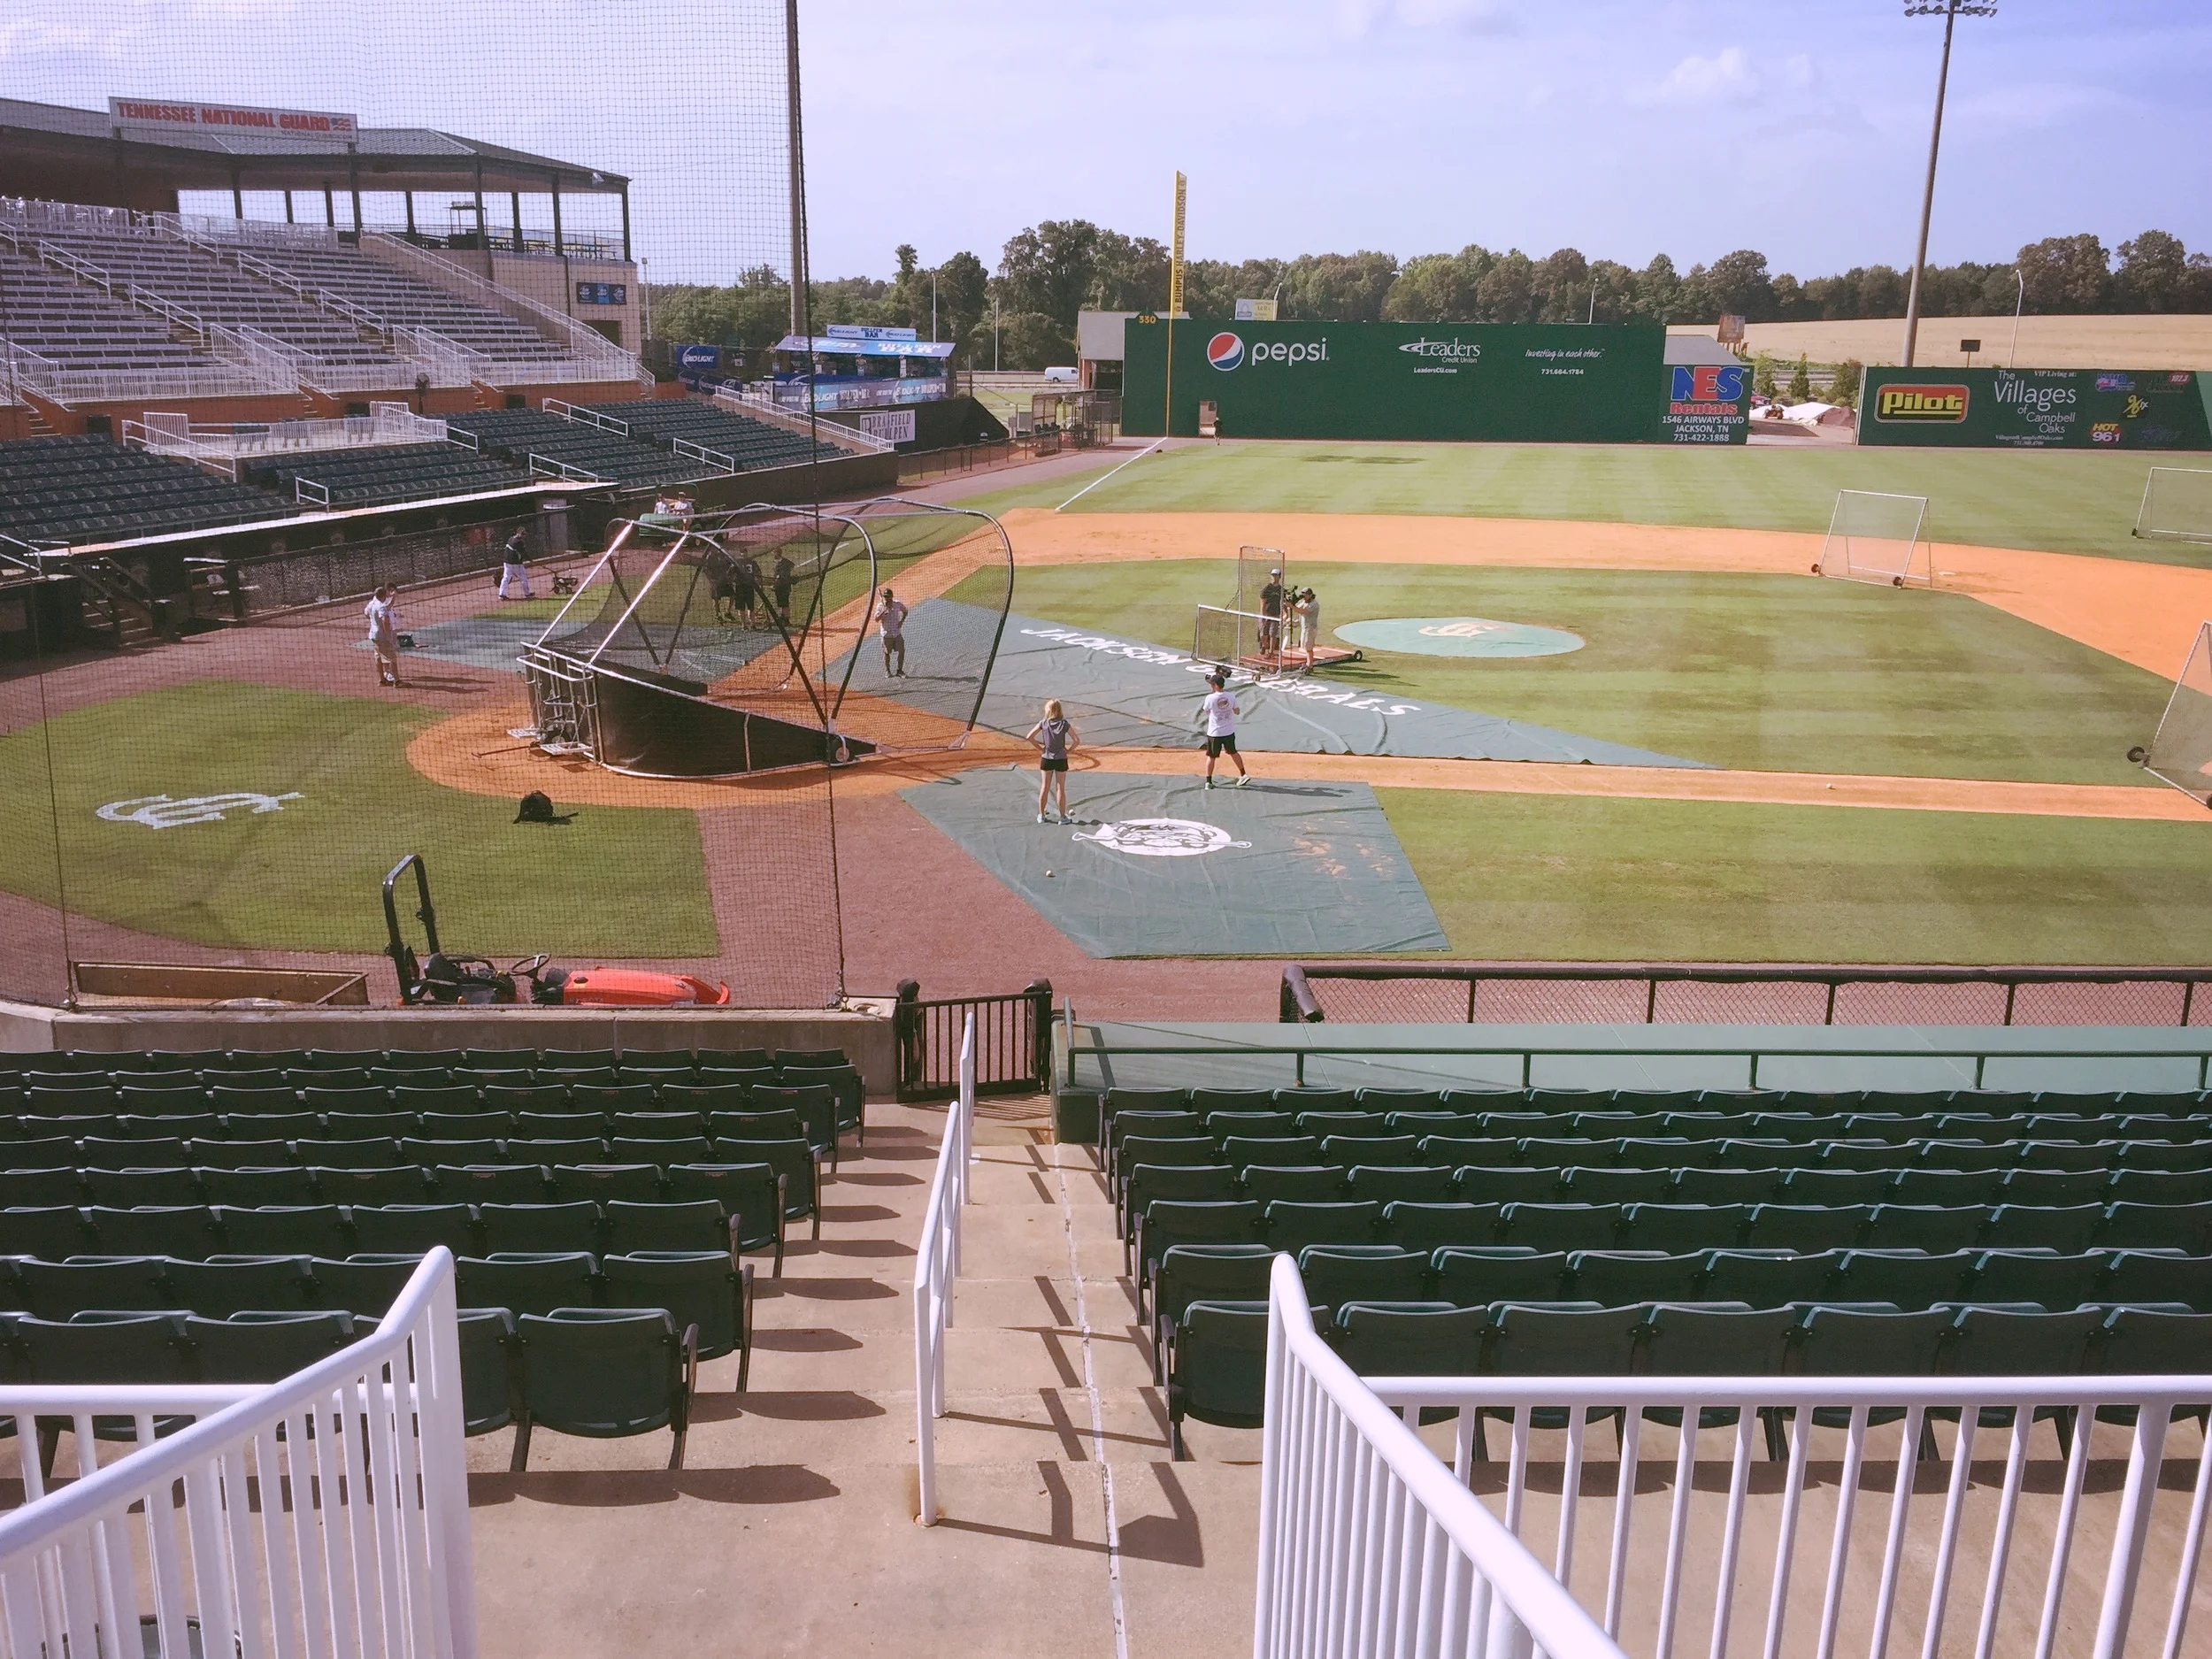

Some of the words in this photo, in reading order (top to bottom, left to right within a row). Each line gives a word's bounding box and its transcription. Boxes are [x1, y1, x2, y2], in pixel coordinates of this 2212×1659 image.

[117, 102, 196, 123] TENNESSEE
[201, 108, 276, 128] NATIONAL
[279, 113, 331, 132] GUARD
[1176, 188, 1187, 266] HARLEY-DAVIDSON
[1174, 270, 1184, 303] BUMPUS
[1251, 337, 1326, 366] pepsi
[1419, 336, 1481, 357] Leaders
[1525, 348, 1556, 361] Investing
[1557, 349, 1564, 358] in
[1564, 348, 1583, 358] each
[1671, 365, 1745, 402] NES
[1998, 370, 2016, 380] The
[1881, 391, 1963, 414] Pilot
[1993, 380, 2077, 412] Villages
[1669, 402, 1739, 415] Rentals
[2016, 403, 2029, 415] of
[2026, 411, 2077, 426] Campbell
[1675, 425, 1716, 434] JACKSON,
[2039, 422, 2066, 434] Oaks
